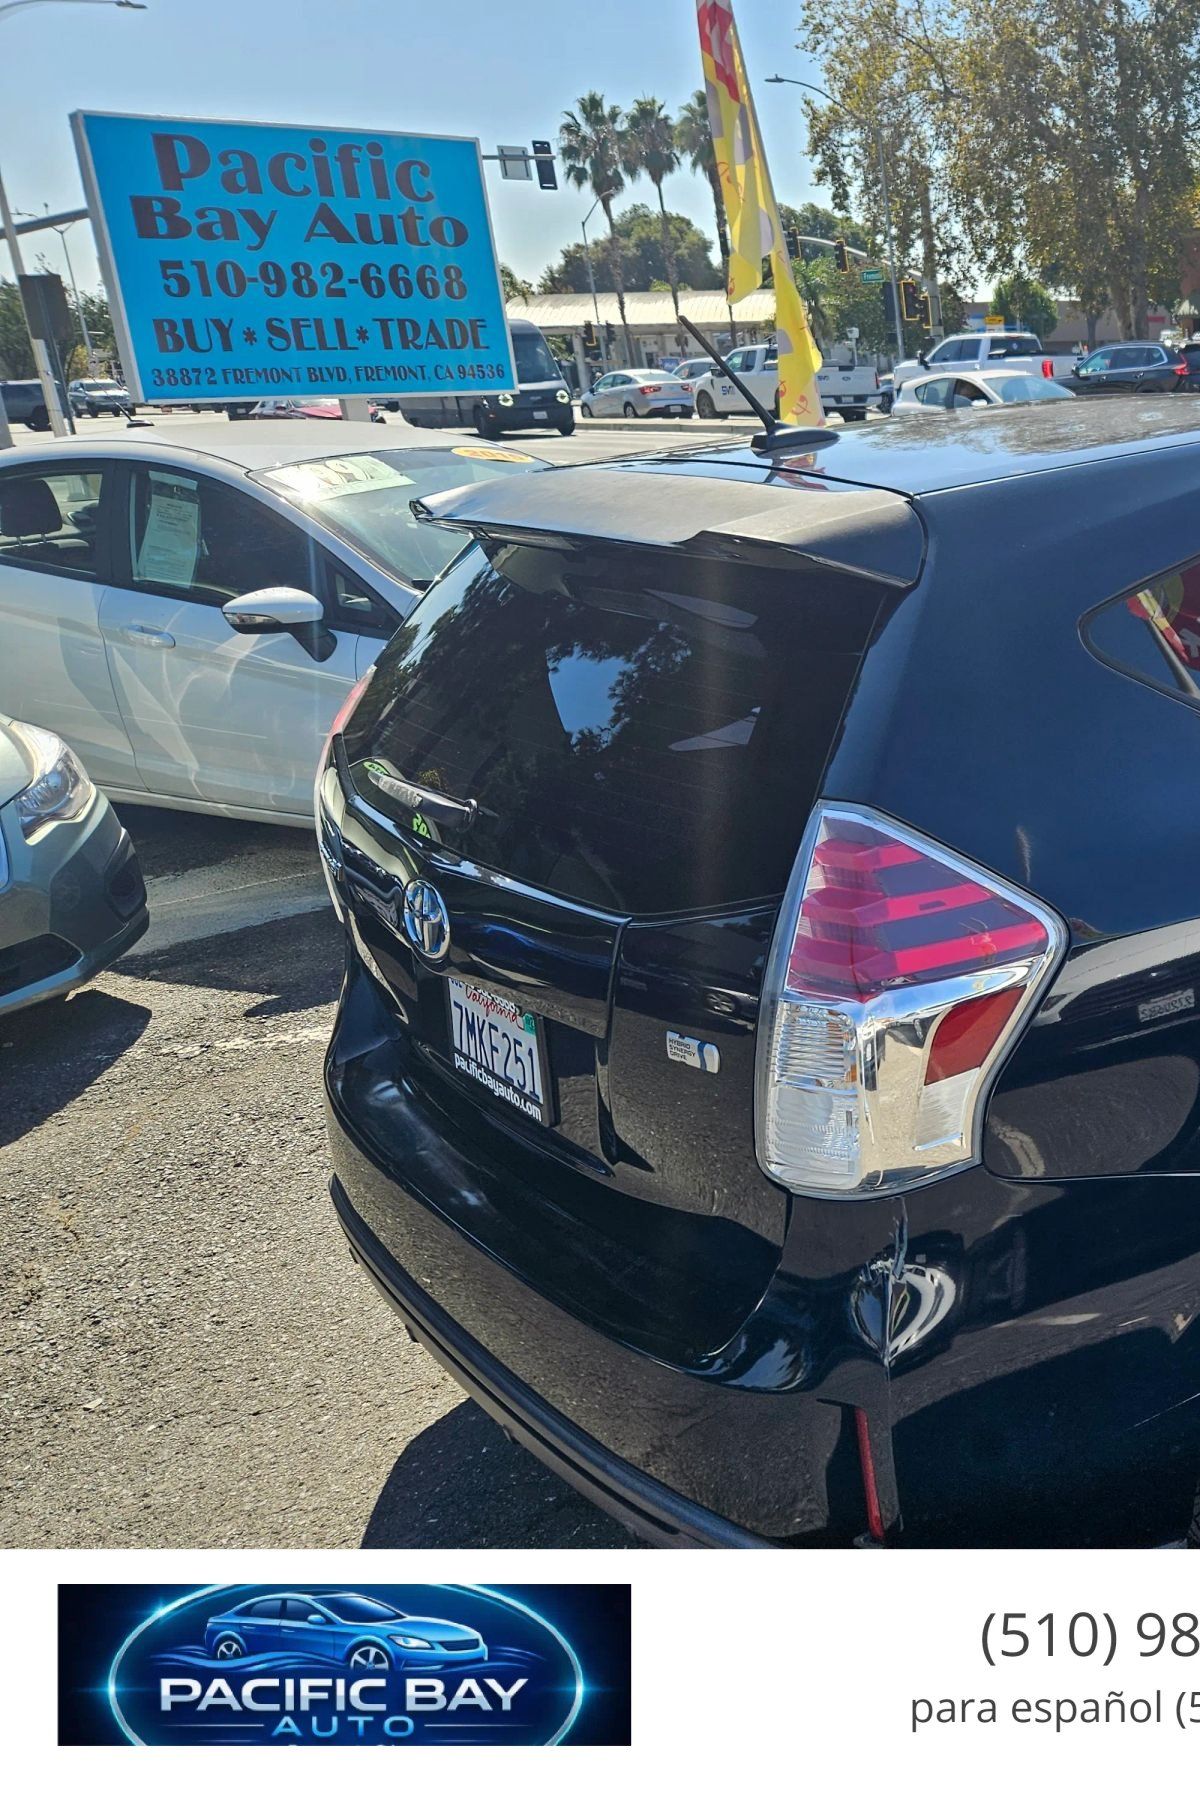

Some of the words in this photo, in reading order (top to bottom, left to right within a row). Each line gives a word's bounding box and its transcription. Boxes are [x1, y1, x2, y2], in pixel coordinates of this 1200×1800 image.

[151, 132, 435, 203] Pacific
[129, 195, 278, 251] Bay
[303, 202, 469, 248] Auto
[158, 259, 468, 300] 510-982-6668
[152, 317, 234, 354] BUY
[265, 316, 360, 352] SELL
[372, 317, 490, 350] TRADE
[151, 366, 217, 387] 38872
[221, 366, 301, 386] FREMONT
[306, 365, 352, 385] BLVD,
[354, 365, 431, 384] FREMONT,
[433, 364, 454, 381] CA
[457, 363, 505, 380] 94536
[453, 1000, 540, 1101] 7MKF251
[669, 1038, 691, 1049] HYBRID
[669, 1044, 696, 1057] SYNERGY
[670, 1050, 687, 1060] DRIVE
[454, 1052, 542, 1122] pacificbayauto.com
